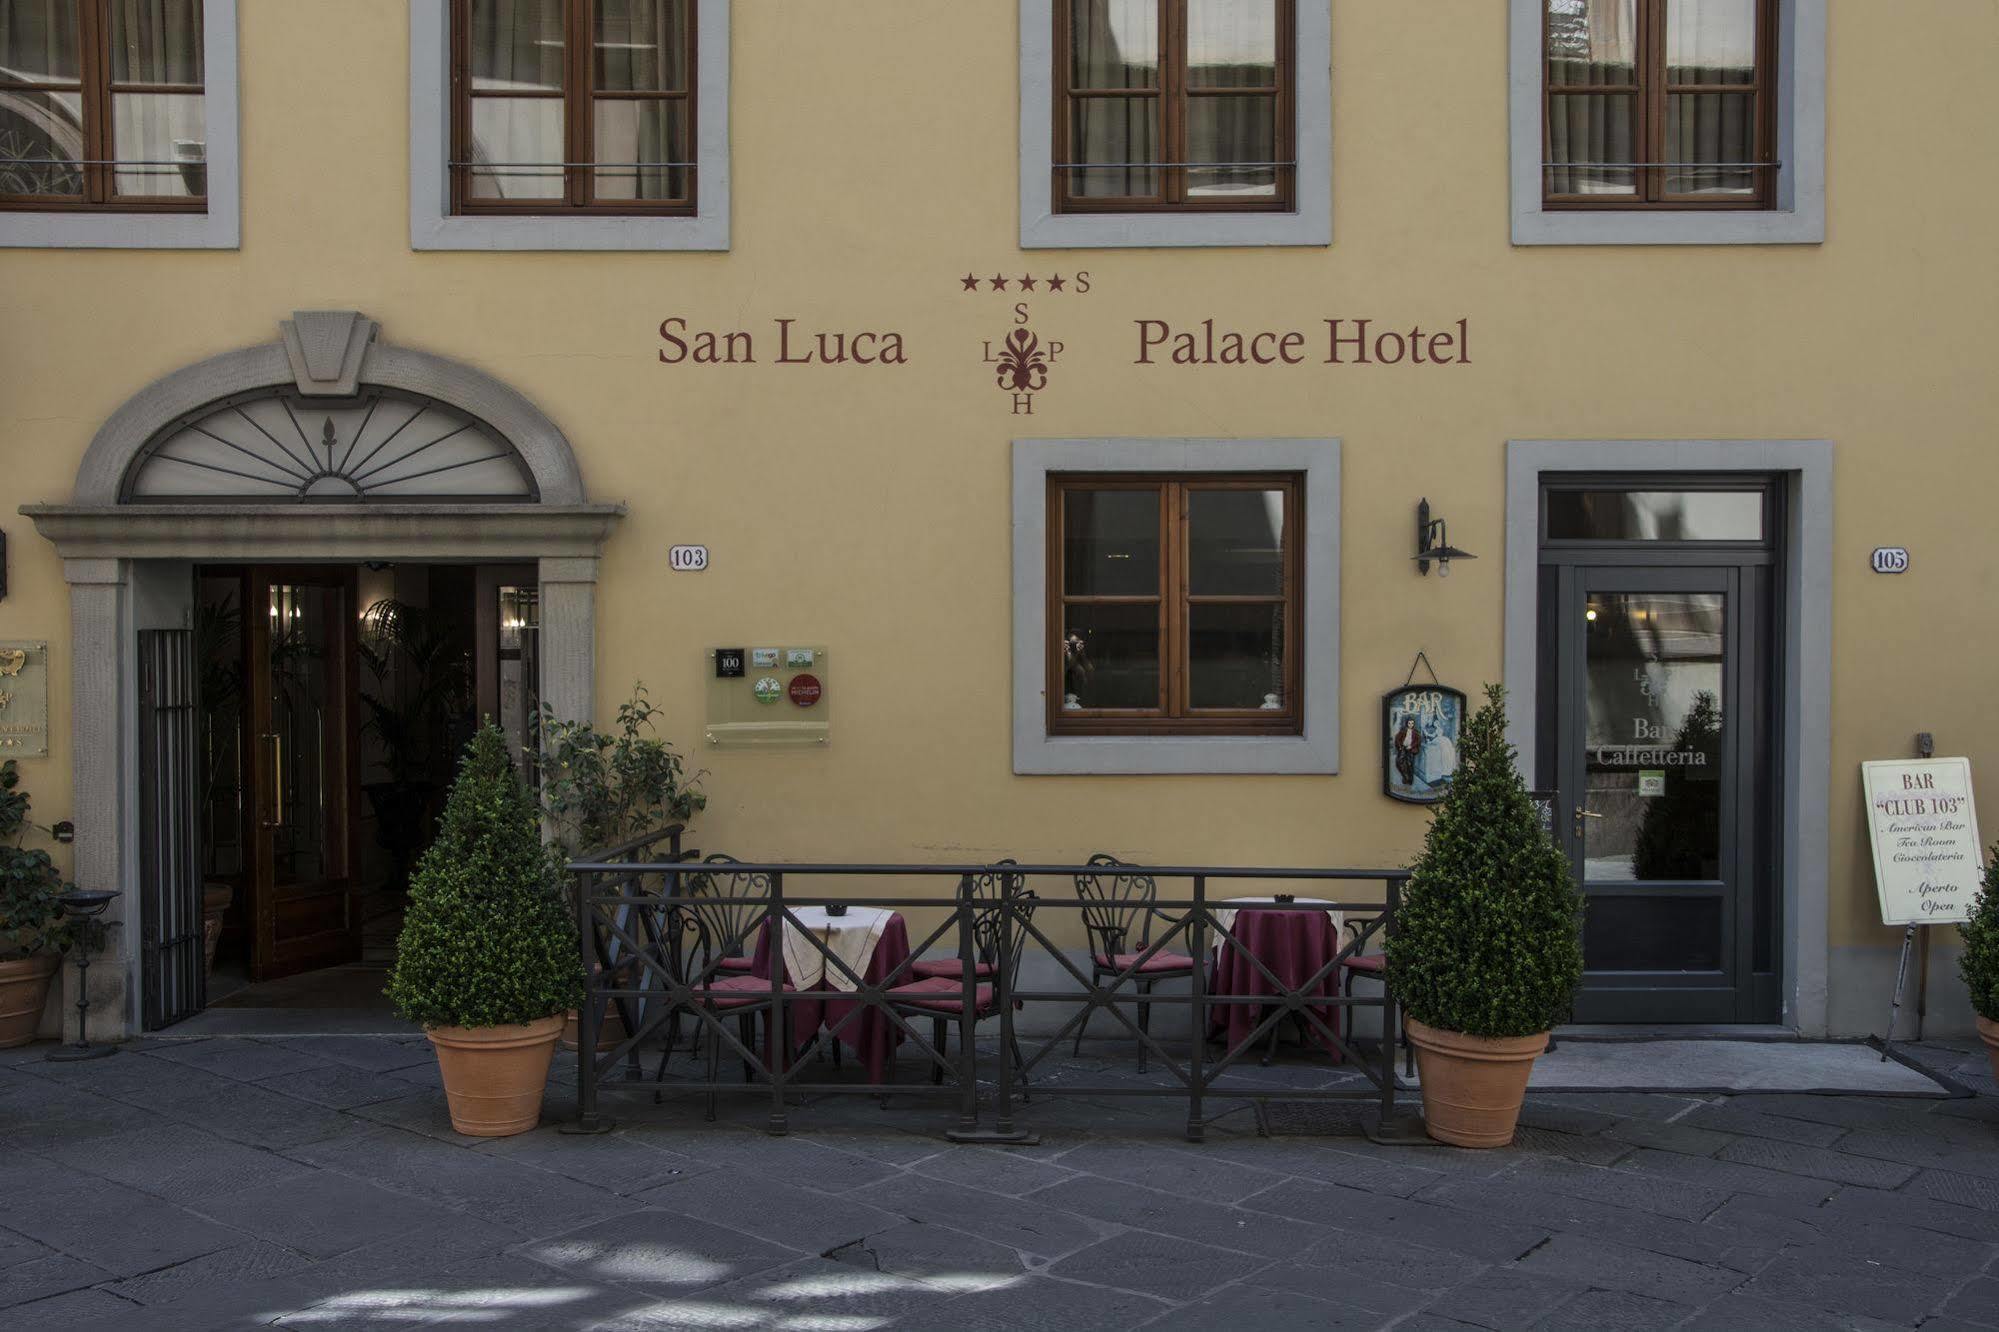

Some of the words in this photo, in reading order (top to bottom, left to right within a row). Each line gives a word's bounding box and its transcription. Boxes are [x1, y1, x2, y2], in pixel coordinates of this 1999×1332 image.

[1014, 302, 1029, 324] S
[658, 317, 757, 364] San
[773, 318, 908, 364] Luca
[1133, 318, 1306, 365] Palace
[1322, 318, 1473, 365] Hotel
[982, 341, 999, 362] L
[1047, 341, 1064, 362] P
[1010, 392, 1035, 414] H
[674, 549, 704, 567] 103
[1877, 551, 1905, 569] 105
[722, 657, 740, 669] 100
[1401, 691, 1449, 721] BAR
[1633, 718, 1671, 739] Bar
[1596, 745, 1706, 765] Caffetteria
[1902, 773, 1934, 790] BAR
[1881, 822, 1937, 833] American
[1939, 820, 1966, 832] Bar
[1896, 837, 1918, 848] Tea
[1920, 836, 1956, 847] Room
[1908, 881, 1958, 897] Aperto
[1920, 899, 1954, 915] Open
